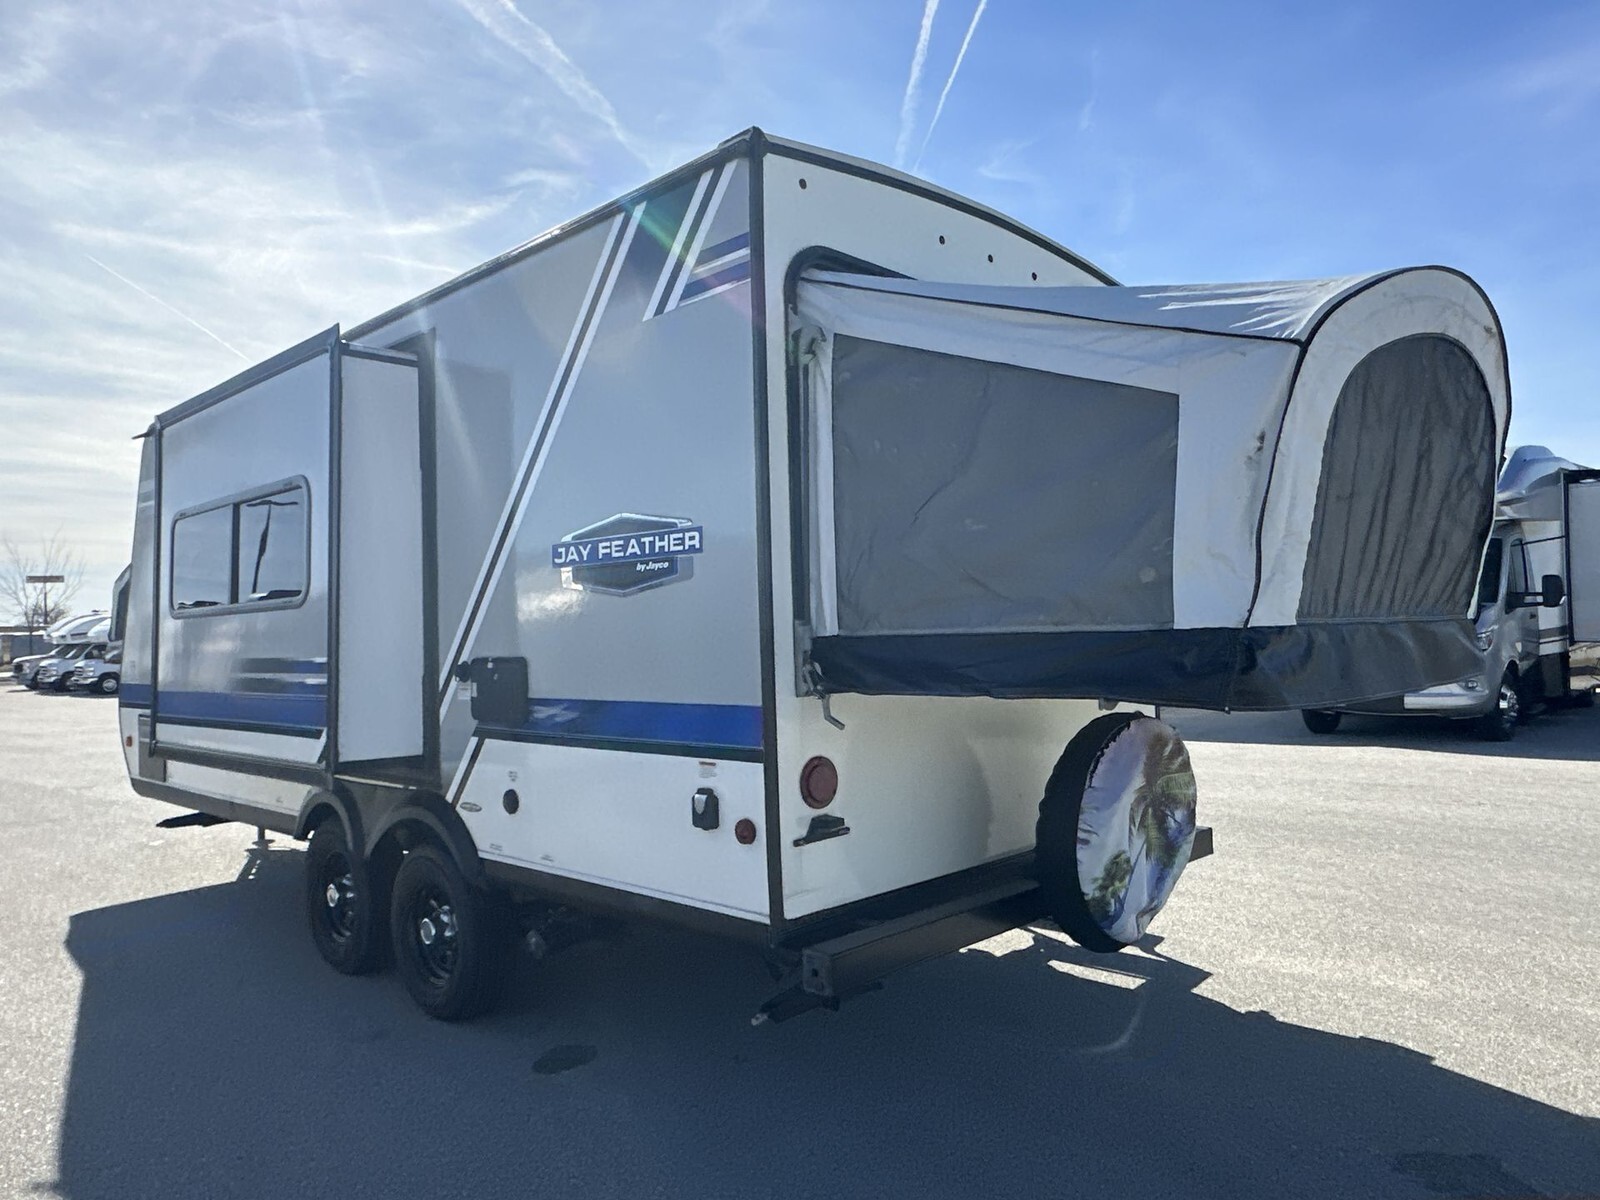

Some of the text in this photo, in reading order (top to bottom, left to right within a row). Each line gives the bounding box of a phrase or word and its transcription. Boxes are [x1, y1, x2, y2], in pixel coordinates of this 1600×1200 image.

[554, 531, 700, 564] JAY FEATHER
[636, 561, 669, 572] by Jayco
